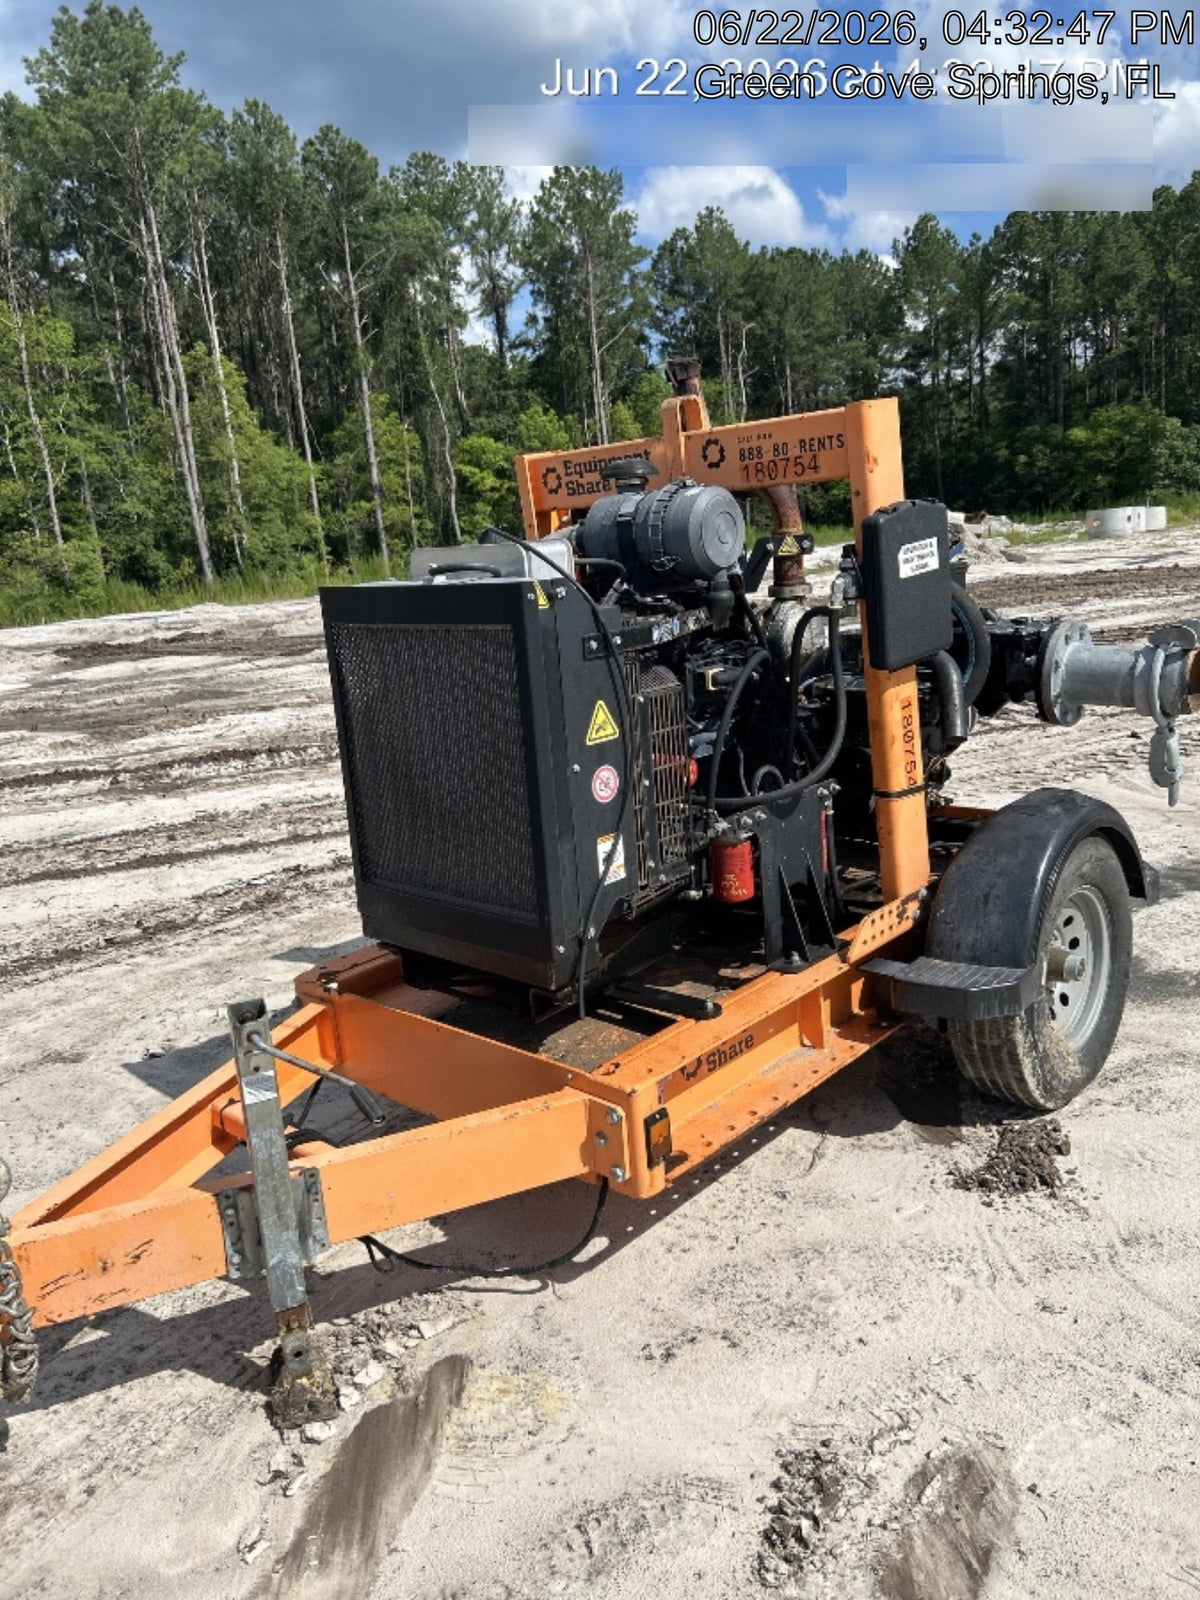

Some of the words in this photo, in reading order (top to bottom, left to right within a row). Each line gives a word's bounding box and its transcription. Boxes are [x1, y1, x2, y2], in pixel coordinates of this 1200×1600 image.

[741, 453, 820, 483] 180754
[565, 479, 612, 497] Share
[706, 1034, 755, 1073] Share
